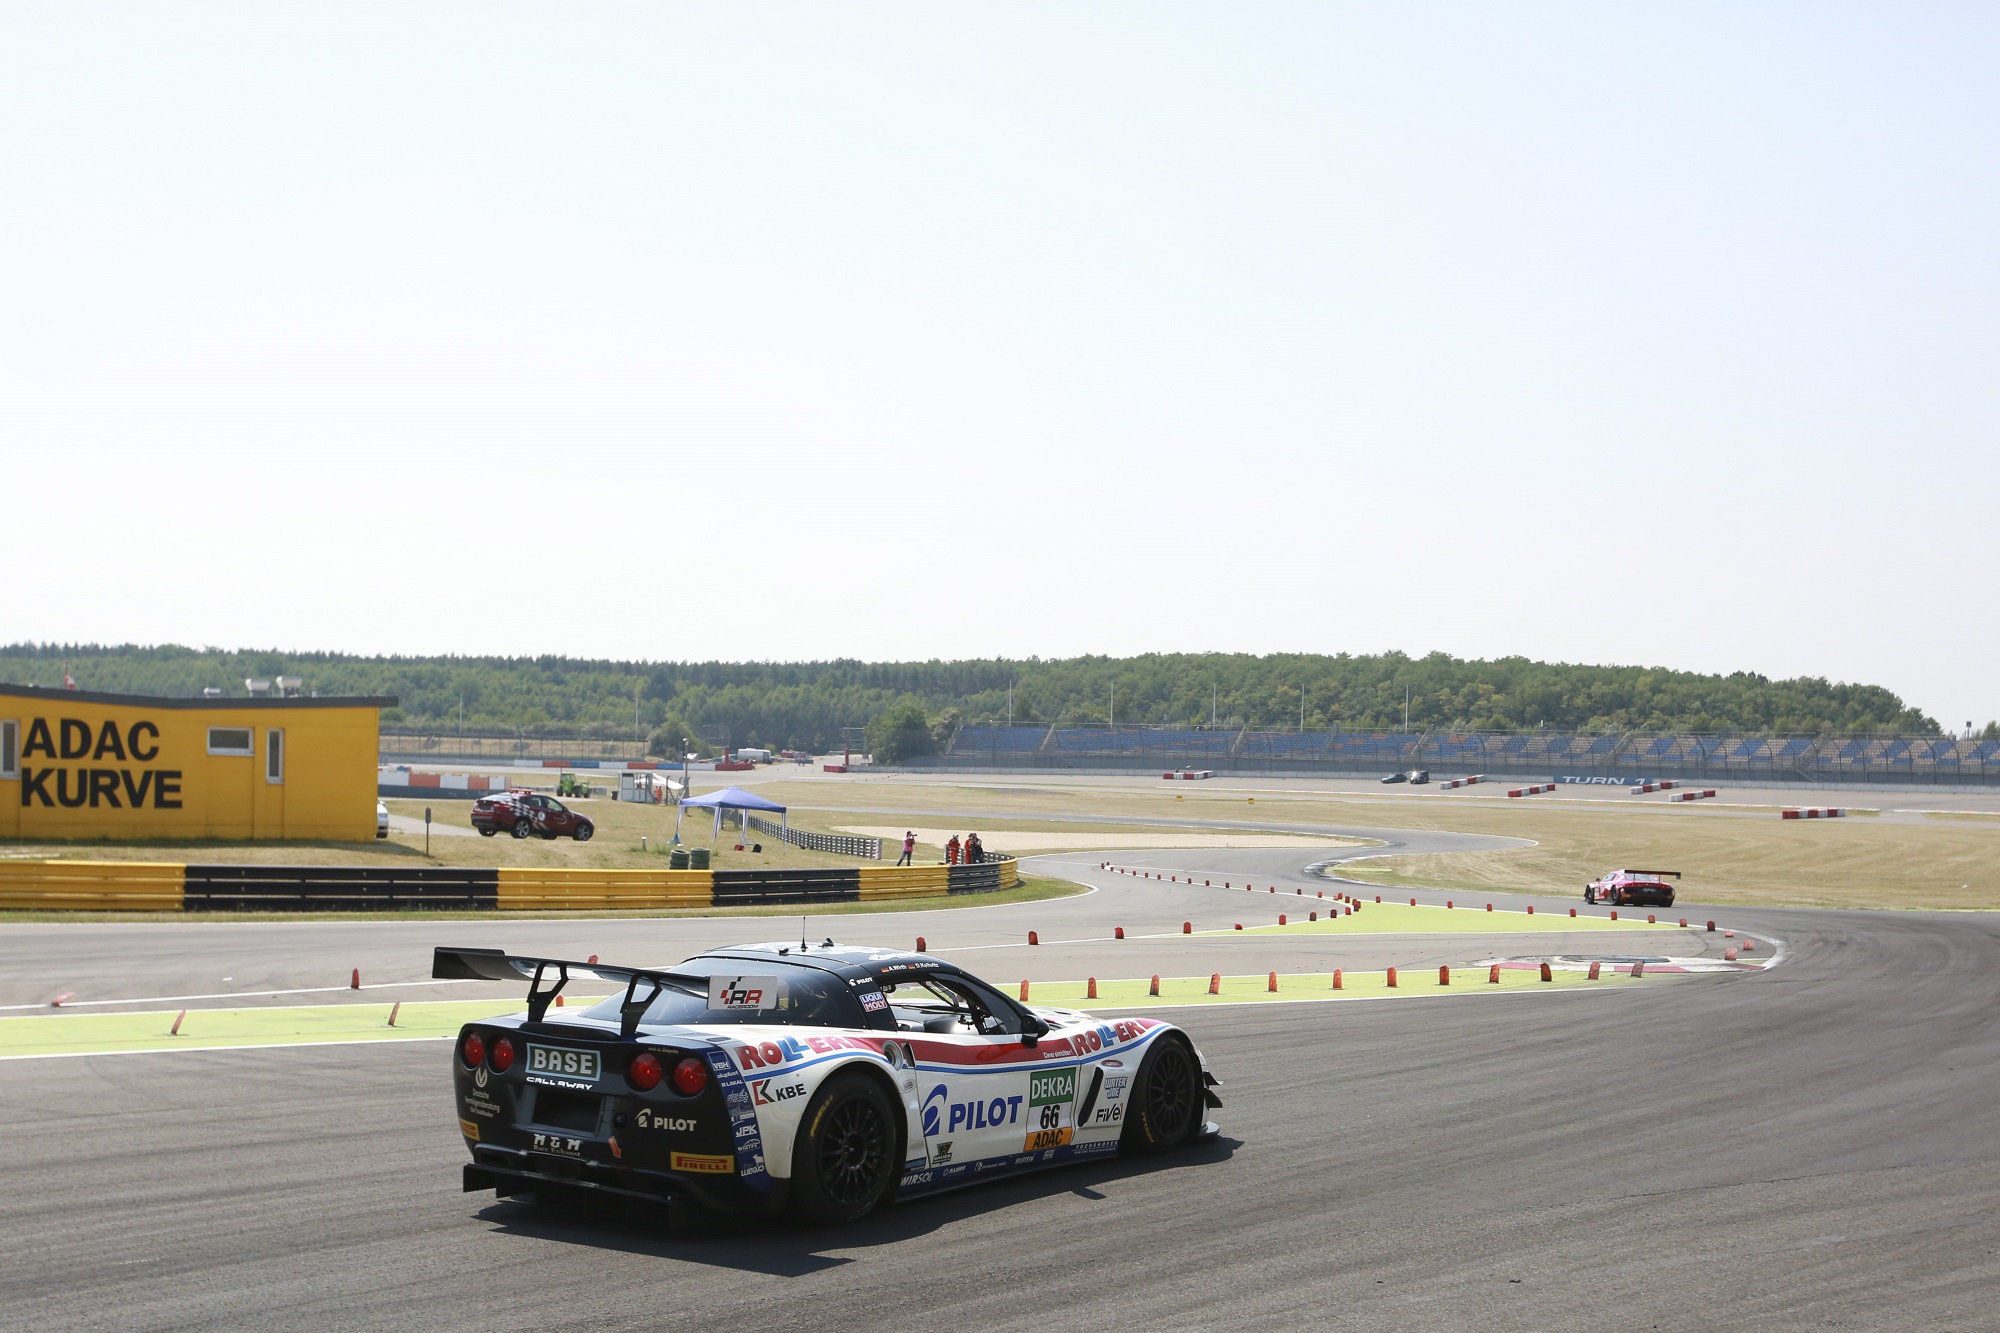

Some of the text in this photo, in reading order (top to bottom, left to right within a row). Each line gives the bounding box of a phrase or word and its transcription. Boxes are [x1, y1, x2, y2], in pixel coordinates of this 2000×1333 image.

[21, 718, 160, 762] ADAC
[21, 767, 183, 809] KURVE
[1562, 776, 1626, 785] TURN
[856, 977, 873, 985] PILOT
[729, 990, 763, 1004] RR
[861, 992, 884, 1003] LIQUI
[865, 1001, 887, 1011] MOLY
[1072, 1020, 1146, 1056] ROLLER
[734, 1036, 850, 1070] ROLLER
[533, 1048, 593, 1075] BASE
[713, 1061, 729, 1069] VBH
[526, 1076, 593, 1090] CALLAWAY
[1031, 1075, 1074, 1100] DEKRA
[1105, 1076, 1127, 1089] WATER
[775, 1083, 807, 1101] KBE
[1107, 1087, 1120, 1099] JOE
[948, 1095, 1023, 1133] PILOT
[1040, 1104, 1061, 1129] 66
[653, 1117, 697, 1132] PILOT
[735, 1124, 757, 1137] JPK
[533, 1134, 581, 1151] M & M
[1033, 1129, 1064, 1149] ADAC
[676, 1156, 727, 1171] PIRELLI
[900, 1172, 933, 1187] WIRSOL
